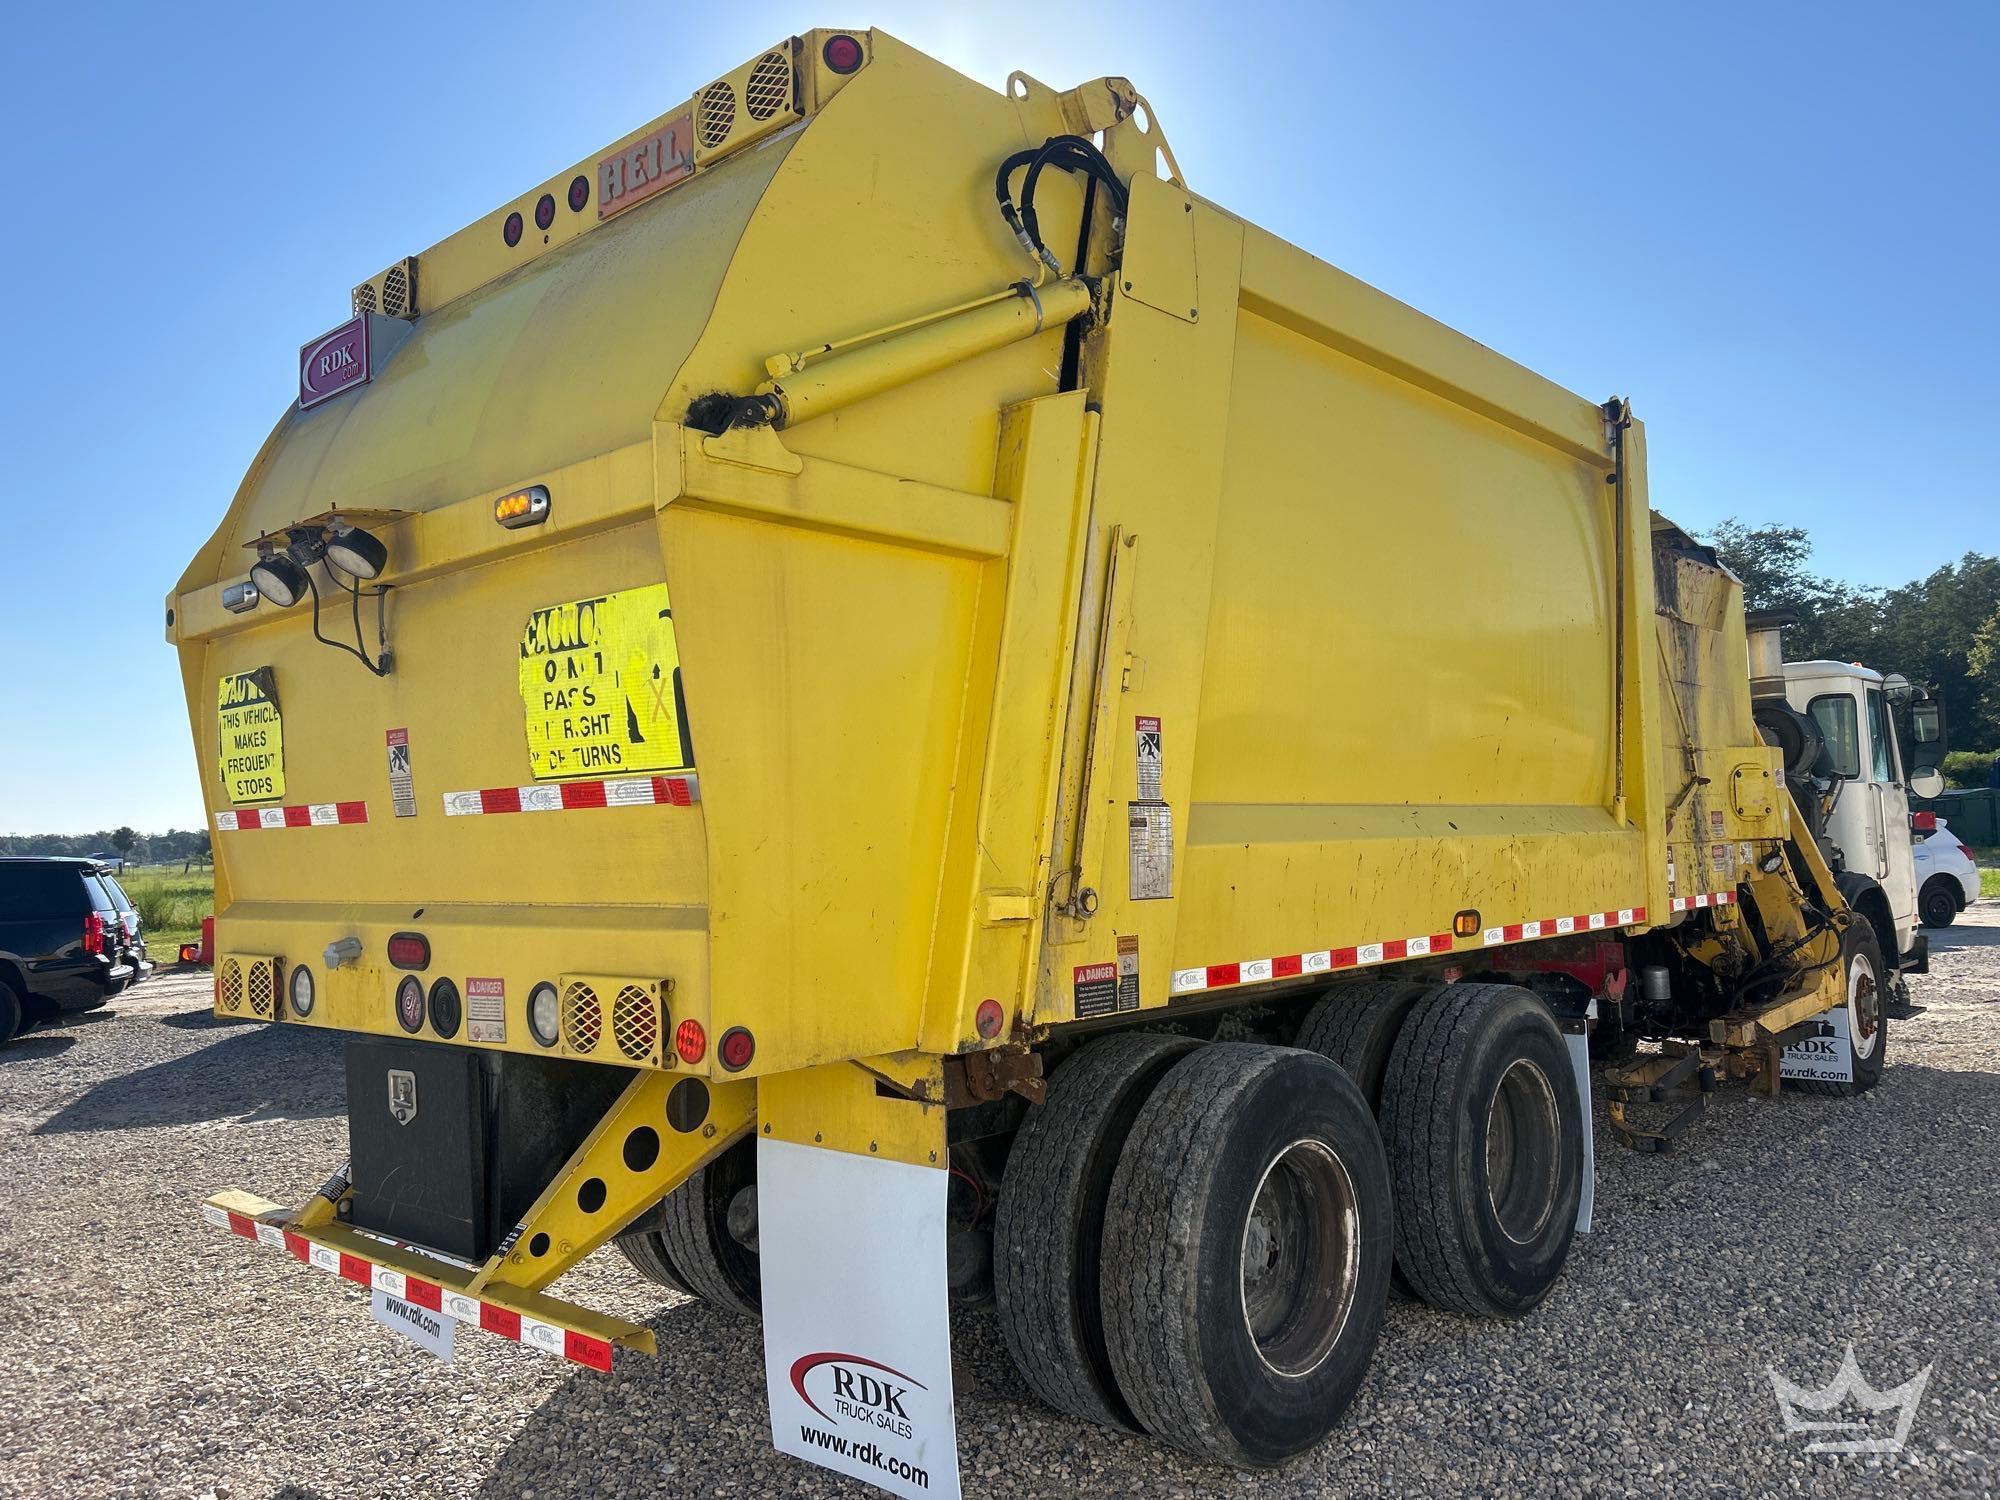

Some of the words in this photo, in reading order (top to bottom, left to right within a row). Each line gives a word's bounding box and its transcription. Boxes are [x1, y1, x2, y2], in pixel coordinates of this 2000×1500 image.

[599, 131, 686, 205] HEIL
[320, 342, 354, 377] RDK
[222, 712, 240, 730] THIS
[243, 706, 279, 726] VEHICLE
[233, 730, 267, 750] MAKES
[236, 776, 273, 796] STOPS
[1085, 966, 1115, 981] DANGER
[475, 981, 503, 994] DANGER
[1787, 1052, 1813, 1061] TRUCK
[1814, 1054, 1839, 1062] SALES
[1780, 1067, 1848, 1081] w.rdk.com
[385, 1296, 440, 1338] www.rdk.com
[831, 1365, 911, 1421] RDK
[835, 1399, 875, 1425] TRUCK
[876, 1414, 913, 1440] SALES
[801, 1425, 929, 1489] www.rdk.com
